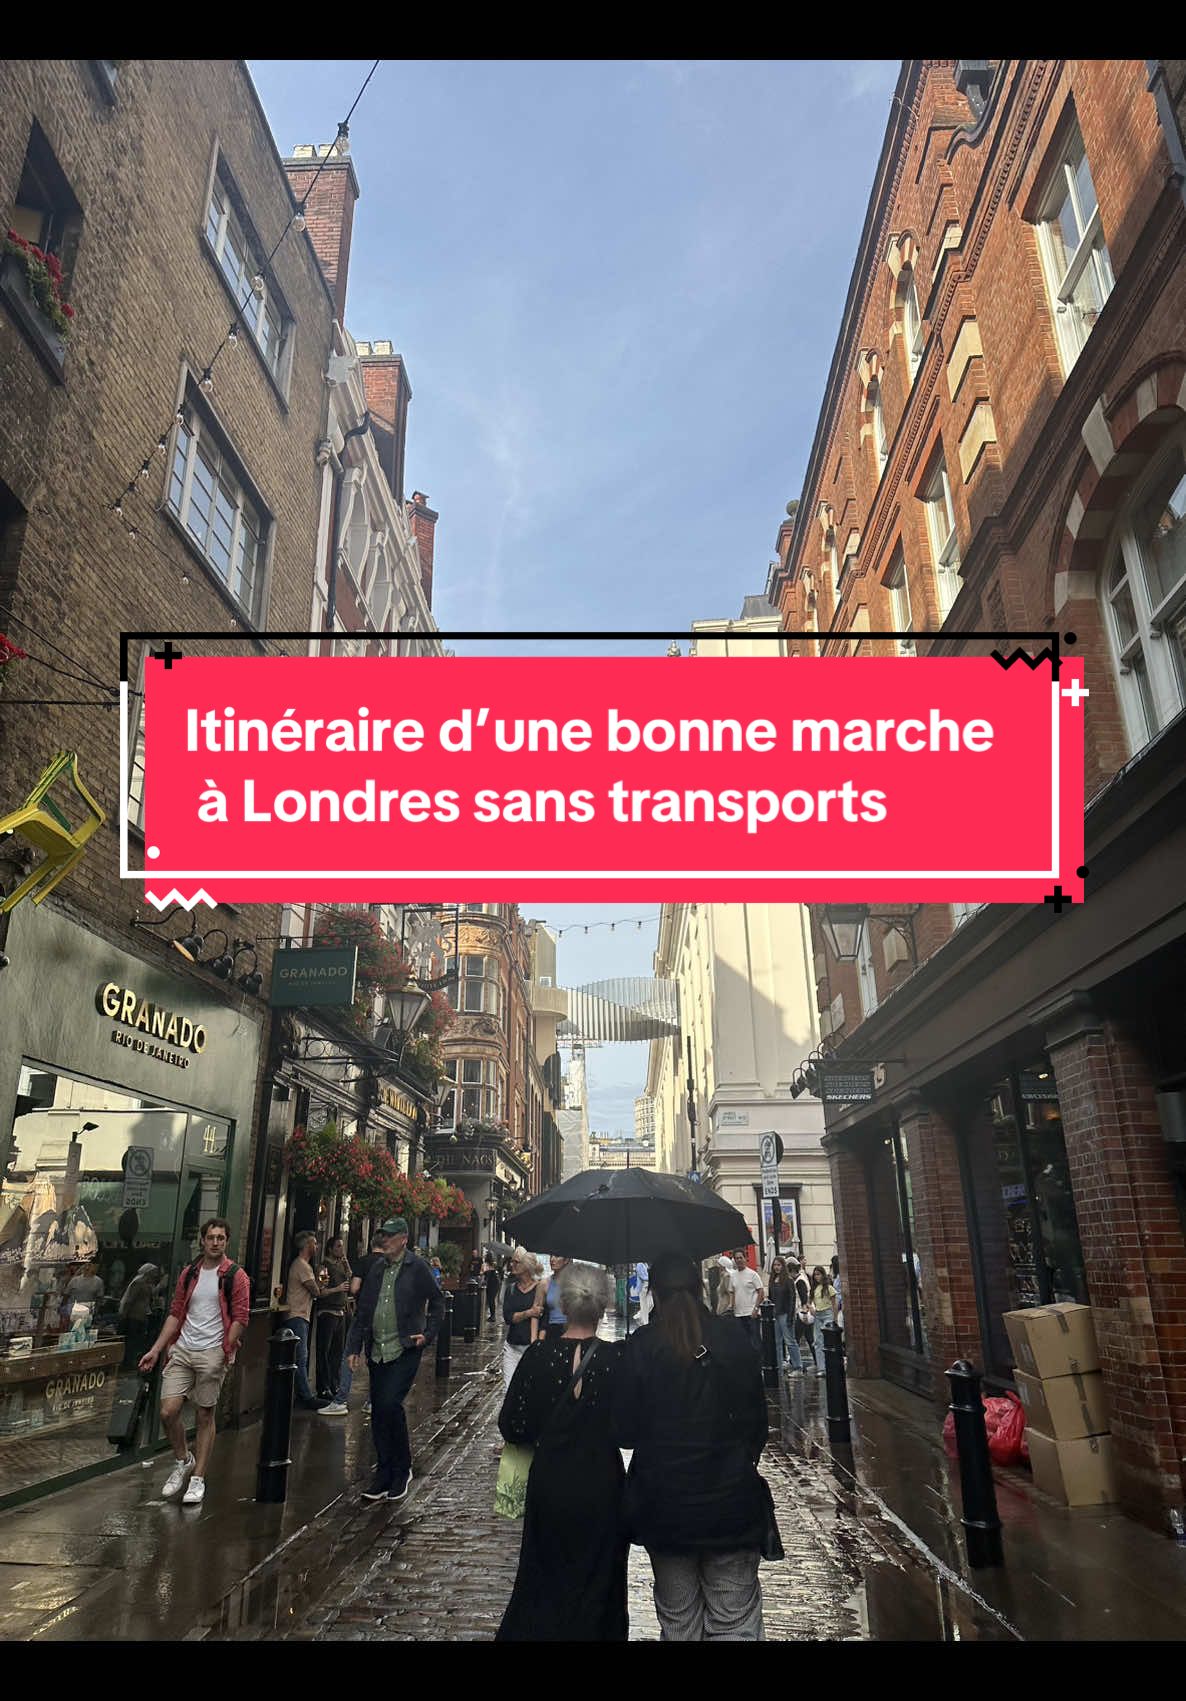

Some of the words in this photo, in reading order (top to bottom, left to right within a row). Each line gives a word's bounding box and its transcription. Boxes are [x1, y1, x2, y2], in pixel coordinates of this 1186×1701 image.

[279, 966, 348, 979] GRANADO
[101, 981, 209, 1055] GRANADO
[114, 1030, 134, 1047] RIO
[136, 1039, 149, 1053] DE
[151, 1046, 191, 1069] JANEIRO
[45, 1371, 105, 1399] GRANADO
